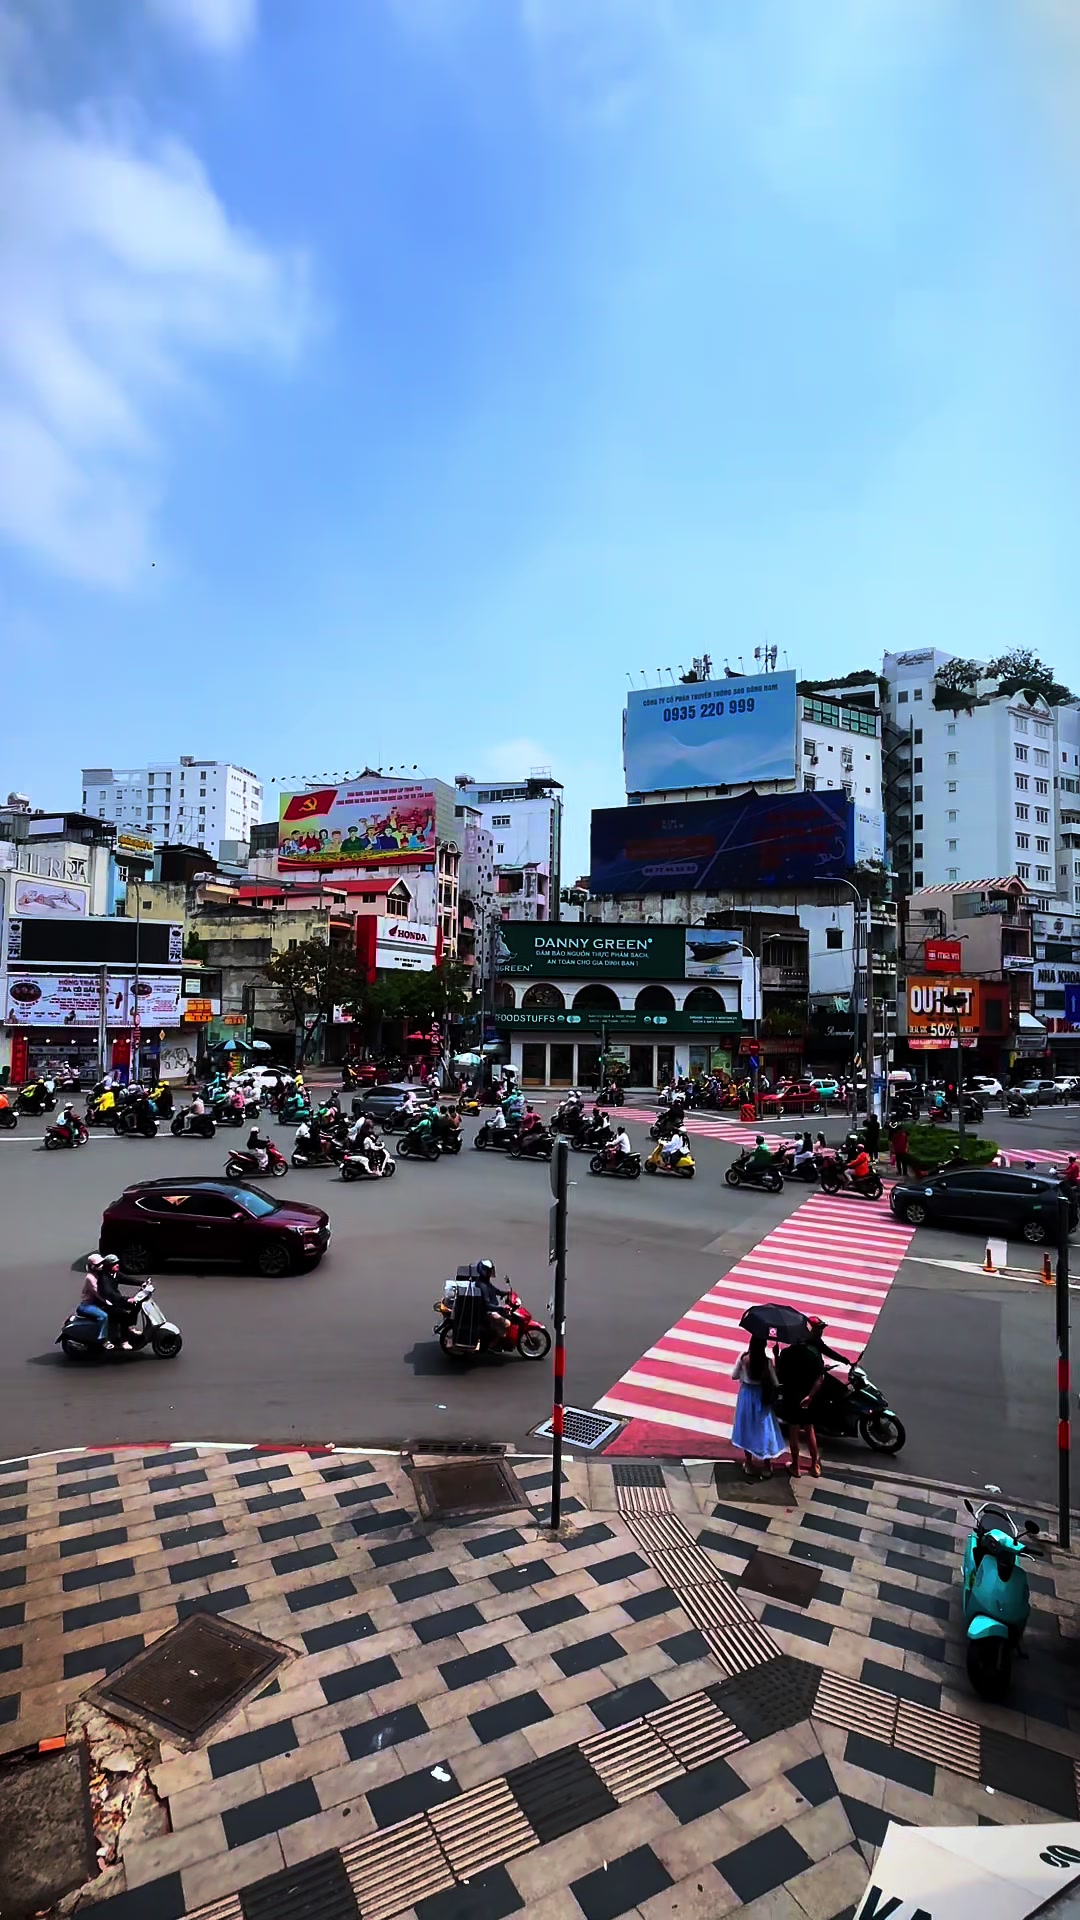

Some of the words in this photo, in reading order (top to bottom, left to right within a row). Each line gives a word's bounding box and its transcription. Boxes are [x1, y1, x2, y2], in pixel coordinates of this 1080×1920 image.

[663, 705, 696, 722] 0935
[700, 701, 724, 718] 220
[729, 697, 755, 714] 999
[397, 929, 427, 941] HONDA
[534, 937, 590, 948] DANNY
[593, 938, 648, 950] GREEN
[1037, 969, 1056, 983] NHA
[930, 1022, 955, 1037] 50%
